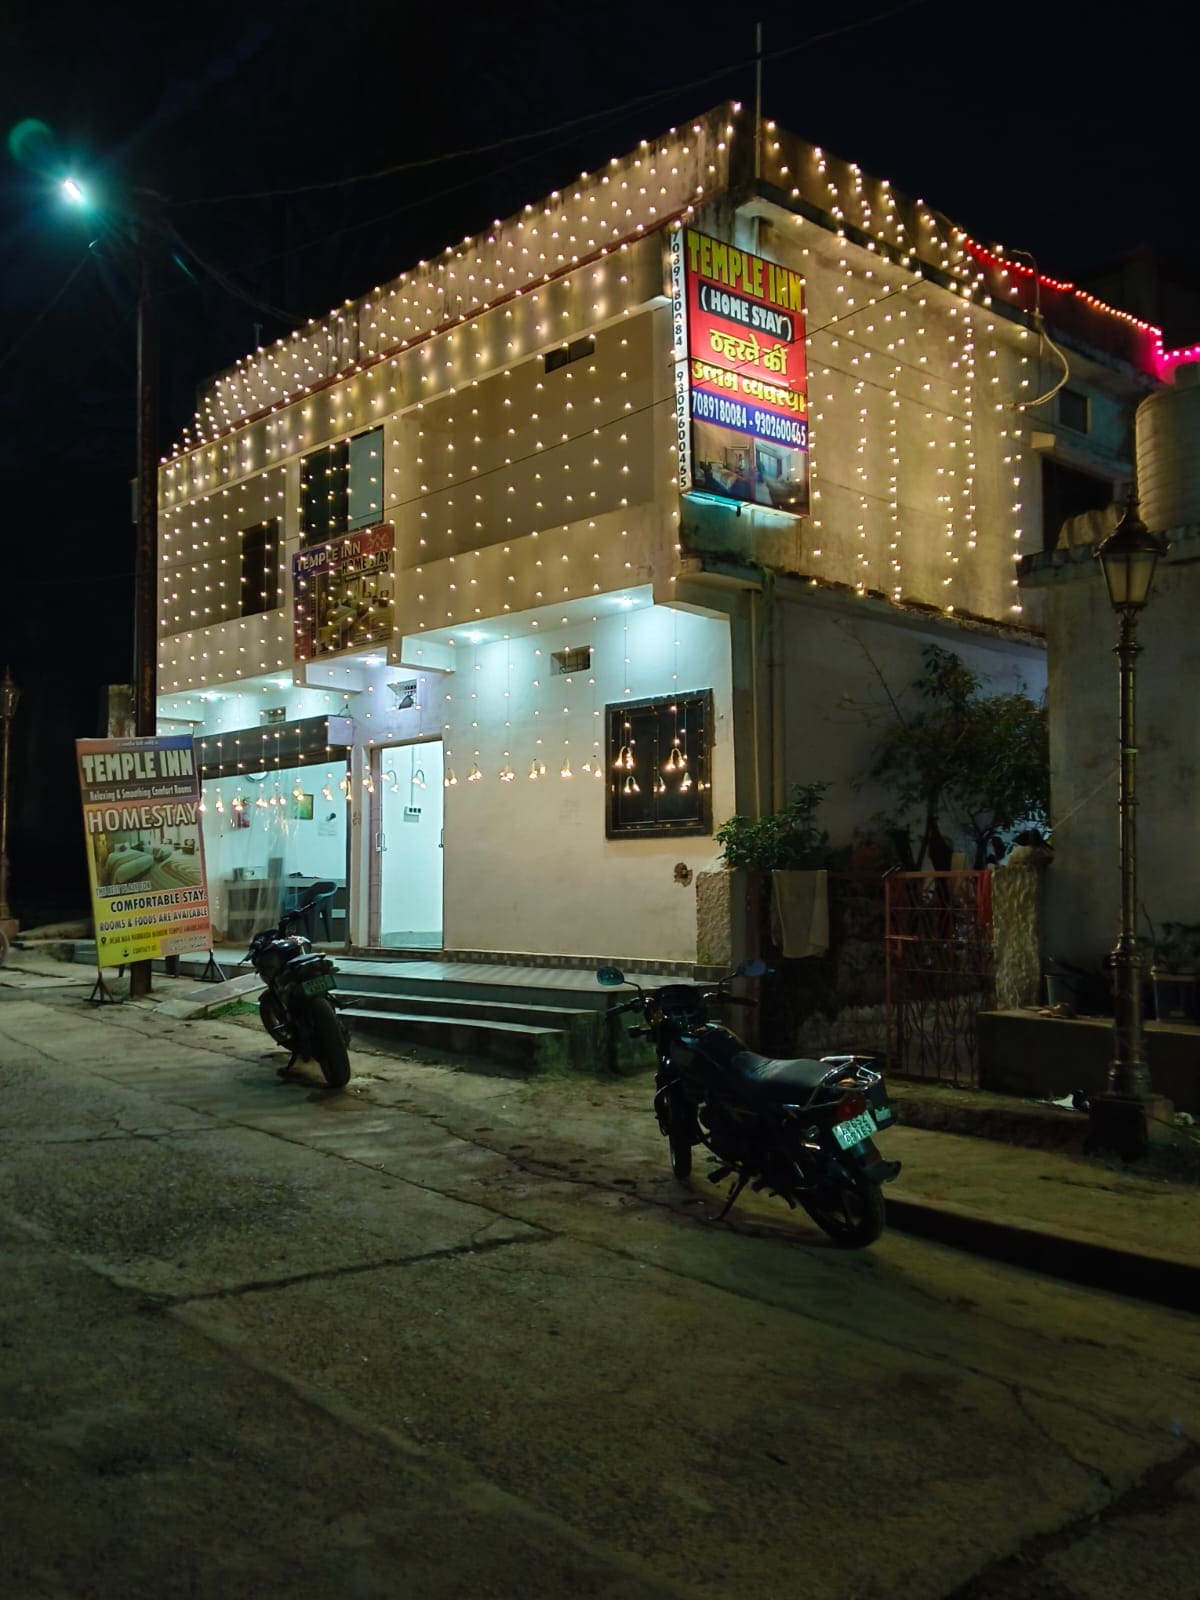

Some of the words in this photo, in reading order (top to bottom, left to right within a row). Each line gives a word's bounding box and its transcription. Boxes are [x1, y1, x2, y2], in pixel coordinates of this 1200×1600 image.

[687, 229, 764, 299] TEMPLE
[768, 262, 803, 313] INN
[763, 343, 789, 375] की
[692, 391, 748, 429] 7089180084
[676, 370, 687, 488] 9302600465
[296, 548, 339, 572] TEMPLE
[340, 541, 361, 559] INN
[82, 751, 157, 784] TEMPLE
[159, 749, 193, 778] INN
[87, 801, 198, 833] HOMESTAY
[100, 920, 126, 932] ROOMS
[135, 915, 158, 926] FOODS
[158, 912, 172, 923] ARE
[173, 907, 209, 921] AVAILABLE
[111, 894, 180, 913] COMFORTABLE
